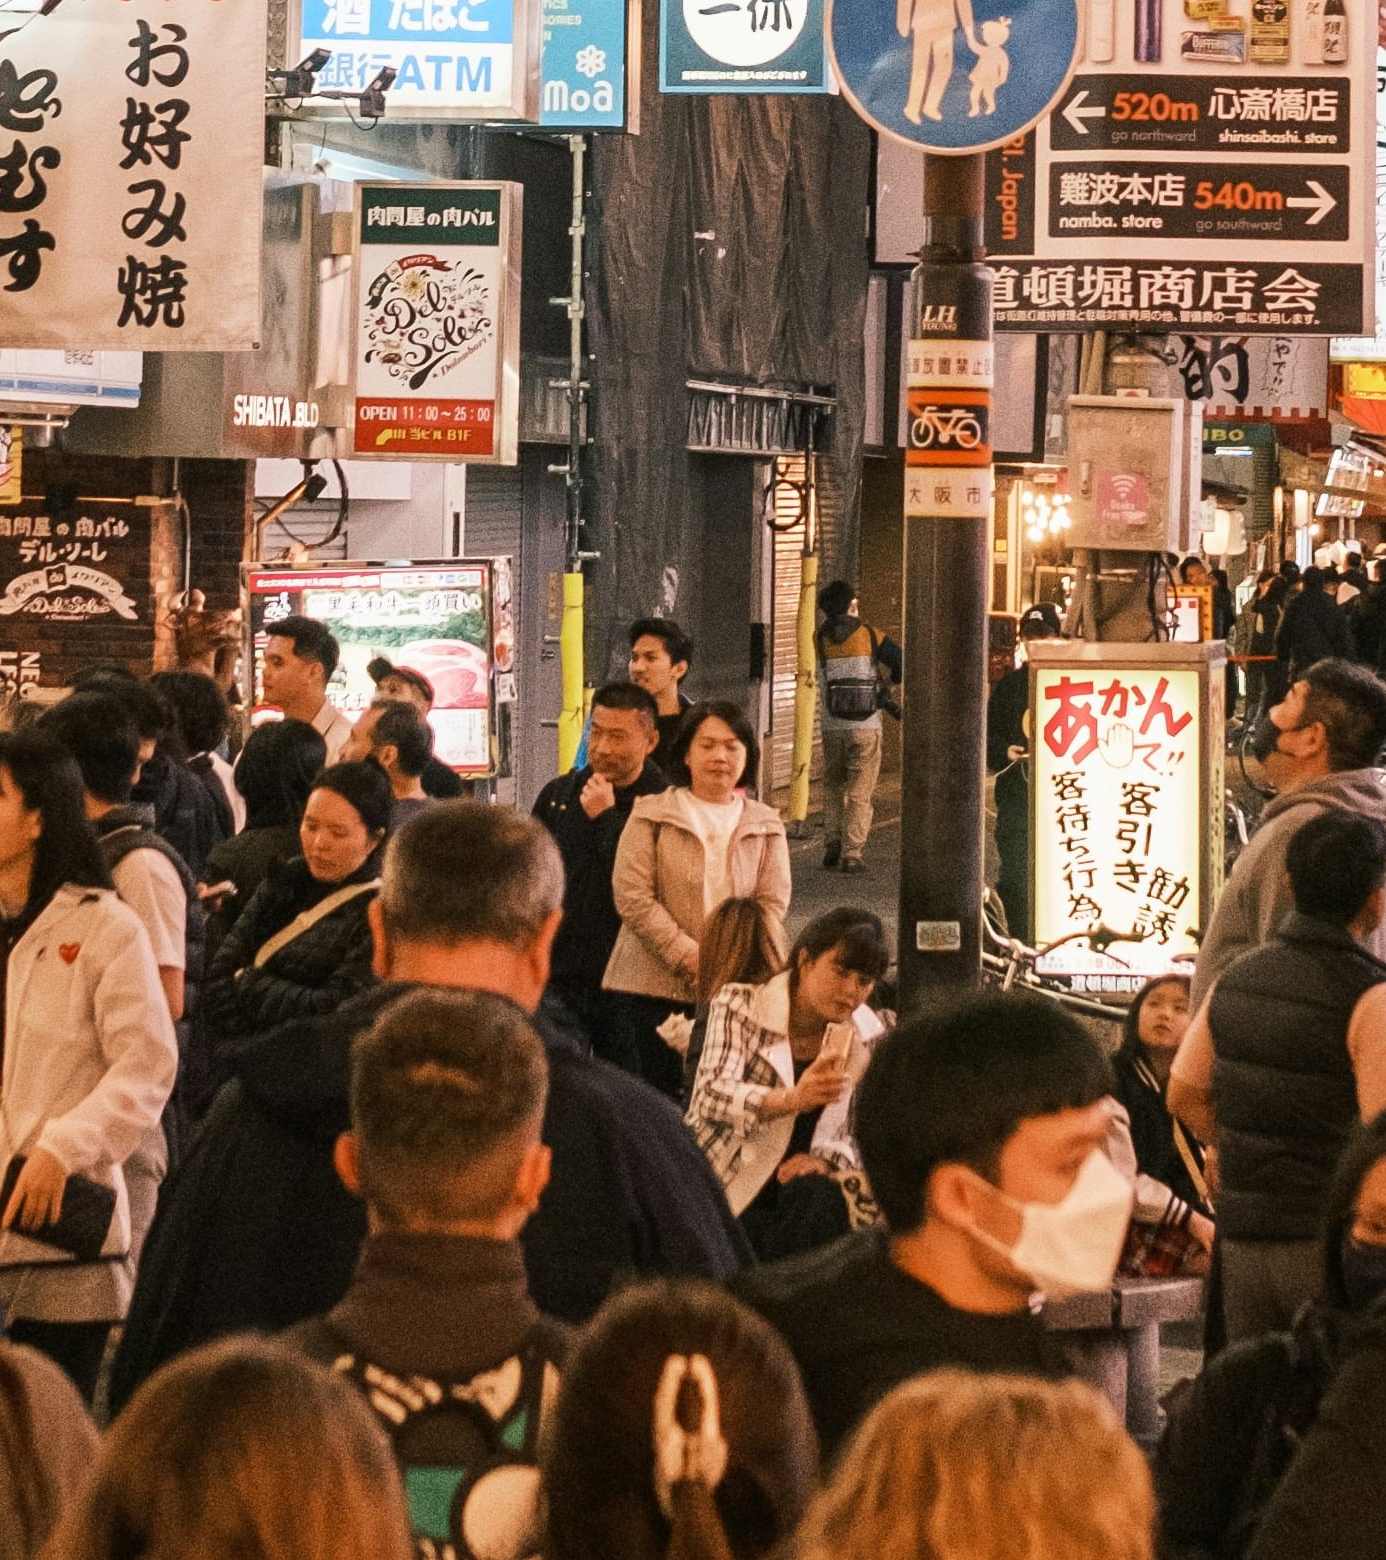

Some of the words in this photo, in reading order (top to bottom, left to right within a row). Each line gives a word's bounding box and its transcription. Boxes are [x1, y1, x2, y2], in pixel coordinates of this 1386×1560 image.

[1111, 92, 1199, 122] 520m
[1208, 86, 1339, 123] 心斎橋店
[1111, 131, 1129, 144] go
[1131, 129, 1197, 143] northward
[116, 19, 191, 330] お好み焼
[1059, 172, 1186, 208] 難波本店
[1193, 181, 1284, 211] 540m
[367, 205, 496, 228] 肉問屋の肉バル
[996, 176, 1019, 241] Japan
[1121, 213, 1164, 229] store
[1196, 220, 1213, 234] go
[993, 264, 1323, 312] 道頓堀商店会
[360, 405, 397, 421] OPEN
[909, 486, 982, 505] 大阪市
[1112, 781, 1162, 894] 客引き
